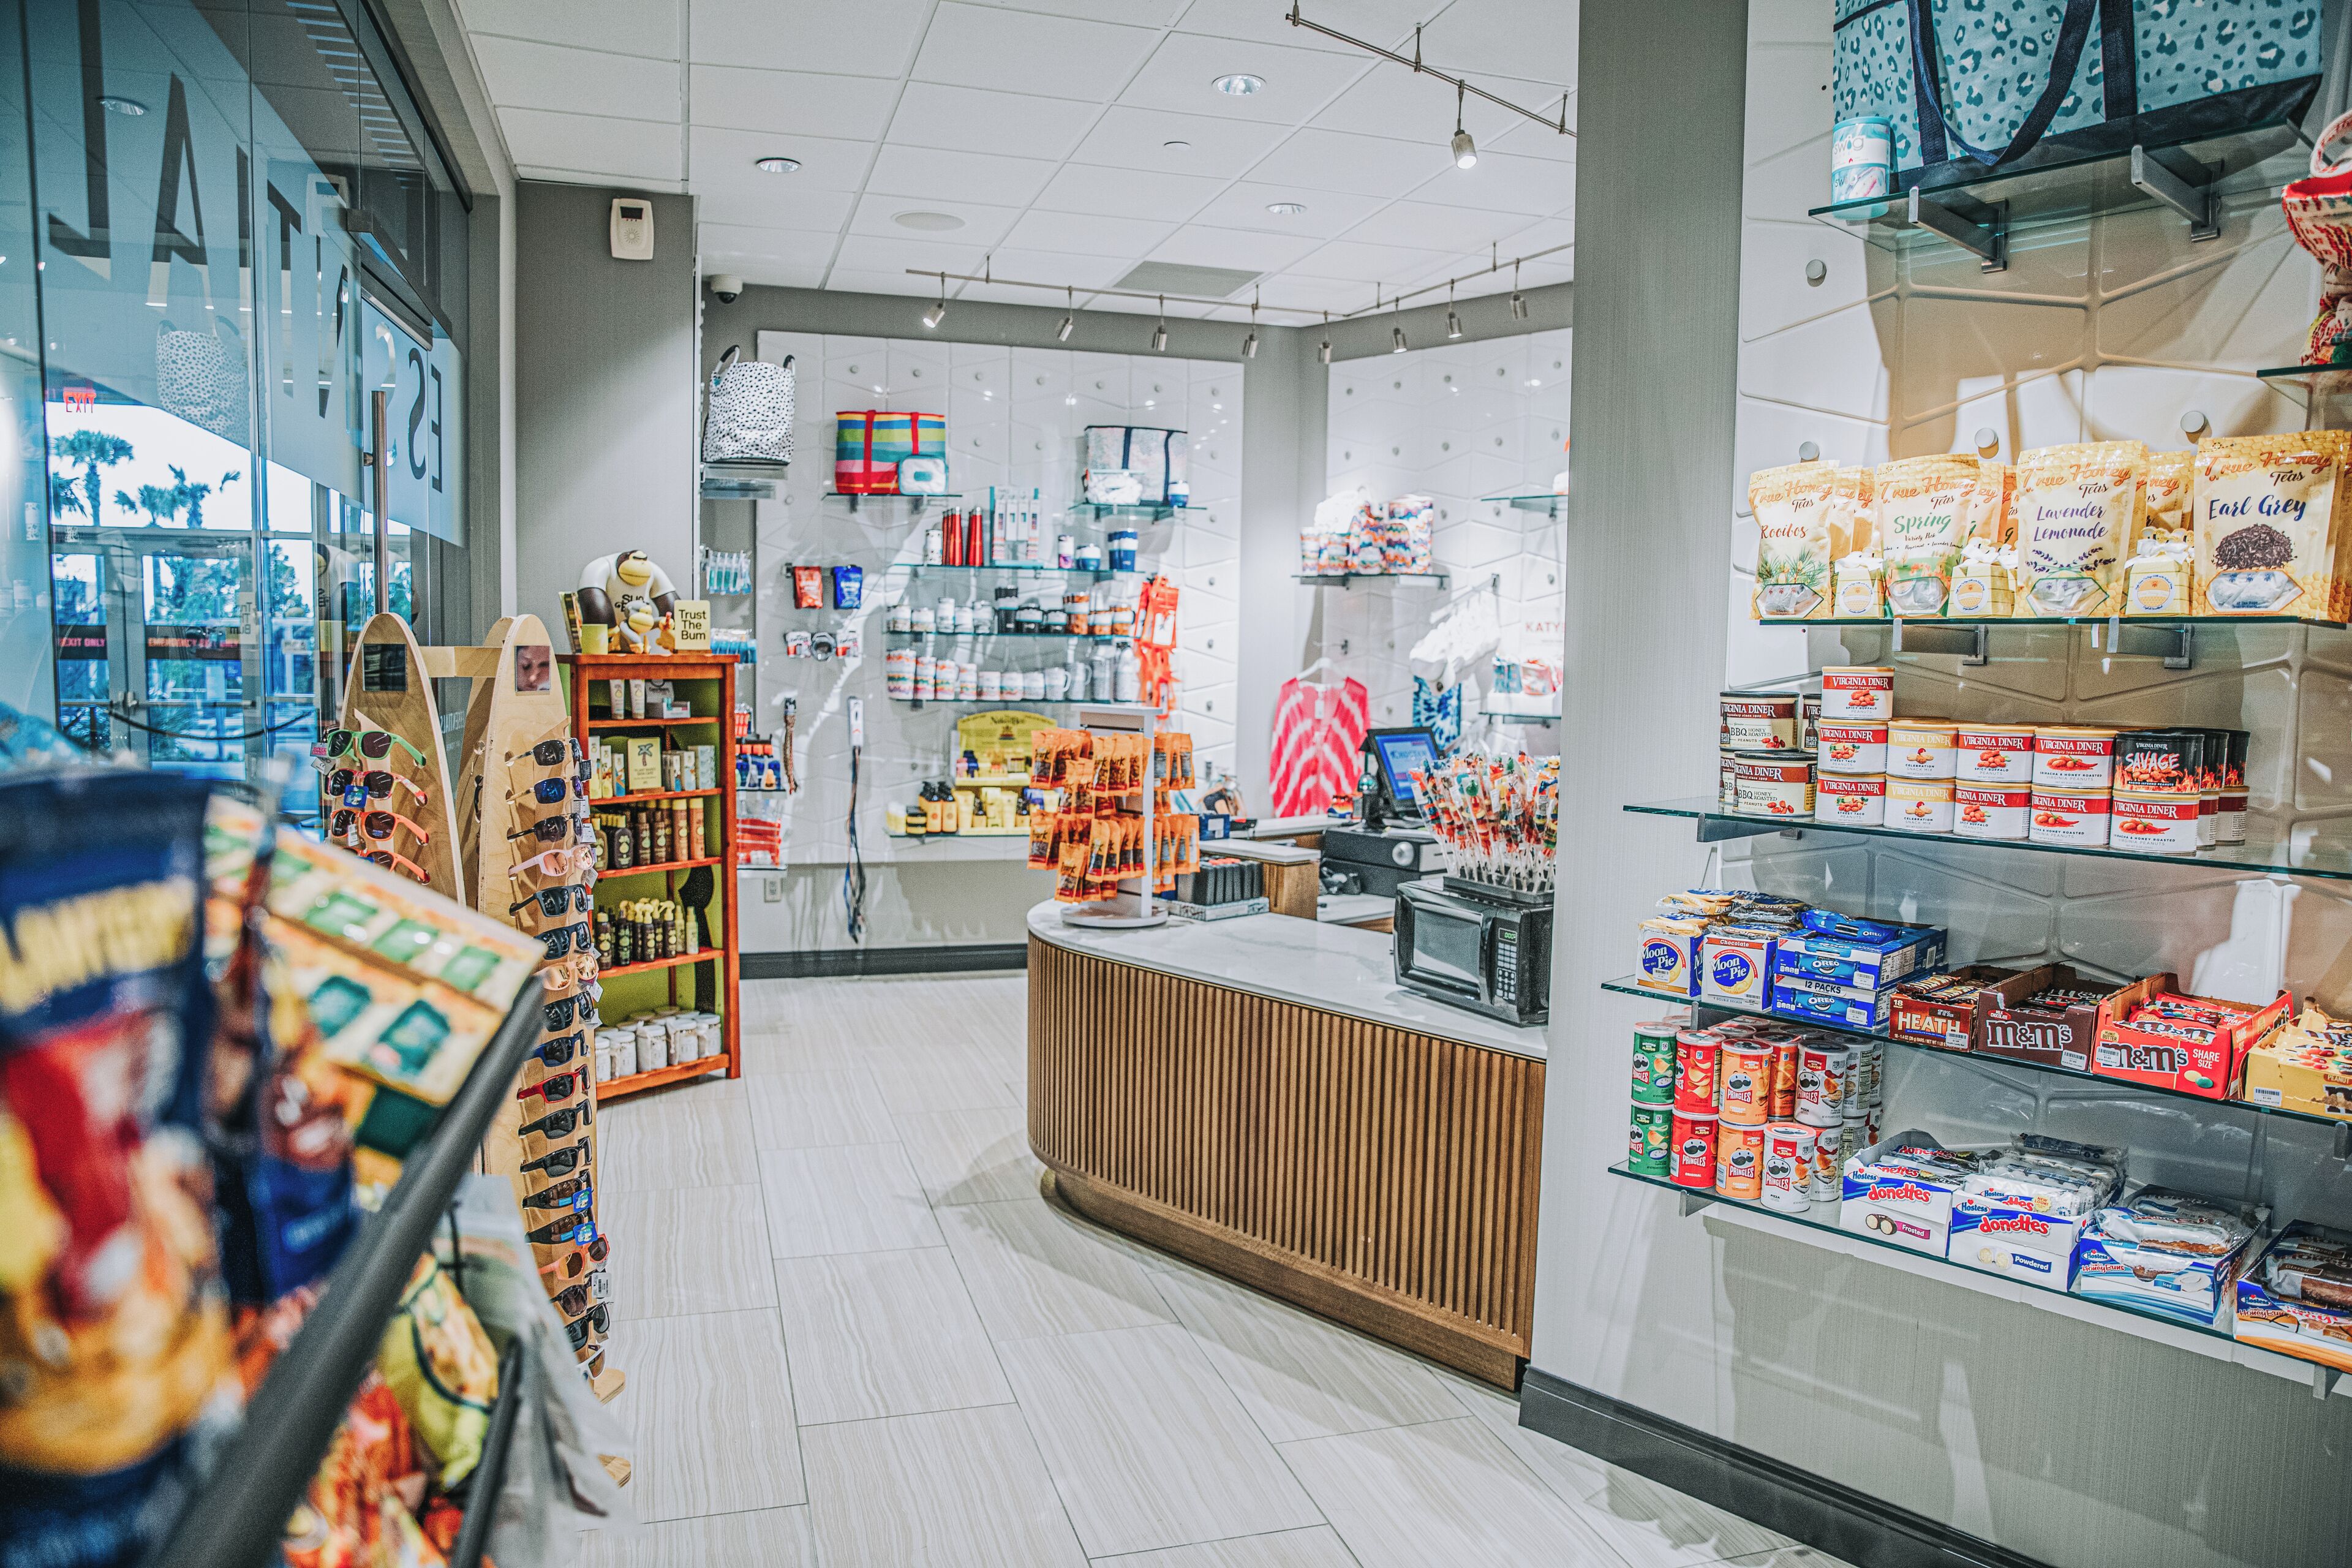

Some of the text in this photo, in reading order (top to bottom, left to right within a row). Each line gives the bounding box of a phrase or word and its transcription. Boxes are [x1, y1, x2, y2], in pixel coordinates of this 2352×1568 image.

[63, 390, 96, 413] EXIT
[2205, 454, 2256, 481] True
[2021, 462, 2132, 493] True Honey
[2270, 470, 2305, 486] Teas
[1751, 480, 1833, 510] True Honey
[1880, 480, 1920, 503] True
[2079, 482, 2109, 498] Teas
[1792, 498, 1814, 513] Teas
[1931, 495, 1955, 509] Teas
[2209, 494, 2307, 521] Earl Grey
[2037, 501, 2107, 521] Lavender
[1894, 512, 1951, 534] Spring
[1761, 523, 1808, 539] Rooibos
[2034, 521, 2109, 542] Lemonade
[679, 609, 706, 619] Trust
[682, 620, 701, 630] The
[681, 630, 706, 640] Bum
[1833, 677, 1889, 689] VIRGINIA DINER
[1748, 704, 1776, 718] DINER
[1731, 727, 1747, 736] BBQ
[1820, 728, 1874, 742] VIRGINIA DINER
[1893, 733, 1924, 743] VIRGINIA
[1927, 734, 1951, 747] DINER
[1963, 736, 2024, 750] VIRGINIA DINER
[2040, 741, 2105, 755] VIRGINIA DINER
[2125, 751, 2180, 773] SAVAGE
[1754, 767, 1784, 782] DINER
[1823, 780, 1880, 795] VIRGINIA DINER
[1891, 786, 1949, 801] VIRGINIA DINER
[1738, 790, 1753, 800] BBQ
[1978, 793, 2007, 806] DINER
[2057, 799, 2088, 813] DINER
[2114, 800, 2179, 819] VIRGINIA DINER
[1715, 905, 1732, 914] Moon
[1643, 946, 1667, 960] Moon
[1657, 955, 1675, 968] Pie
[1711, 957, 1740, 973] Moon
[1729, 966, 1747, 980] Pie
[1814, 983, 1841, 994] PACKS
[1898, 1011, 1960, 1034] HEATH
[1986, 1020, 2073, 1052] m&m's
[2193, 1048, 2220, 1062] SHARE
[2197, 1059, 2213, 1069] SIZE
[2328, 1074, 2350, 1084] PEANUT
[1727, 1088, 1751, 1102] PRINGLES
[1797, 1090, 1818, 1102] PRINGLES
[1682, 1155, 1706, 1167] PRINGLES
[1729, 1166, 1754, 1178] PRINGLES
[1852, 1170, 1877, 1181] Hostess
[1766, 1177, 1790, 1191] PRINGLES
[1868, 1183, 1931, 1203] donettes
[1962, 1202, 1989, 1213] Hostess
[1902, 1225, 1924, 1237] Frosted
[1979, 1215, 2049, 1235] donettes
[2015, 1256, 2049, 1271] Powdered
[2245, 1295, 2269, 1305] Hostess
[2329, 1331, 2348, 1341] Glazed
